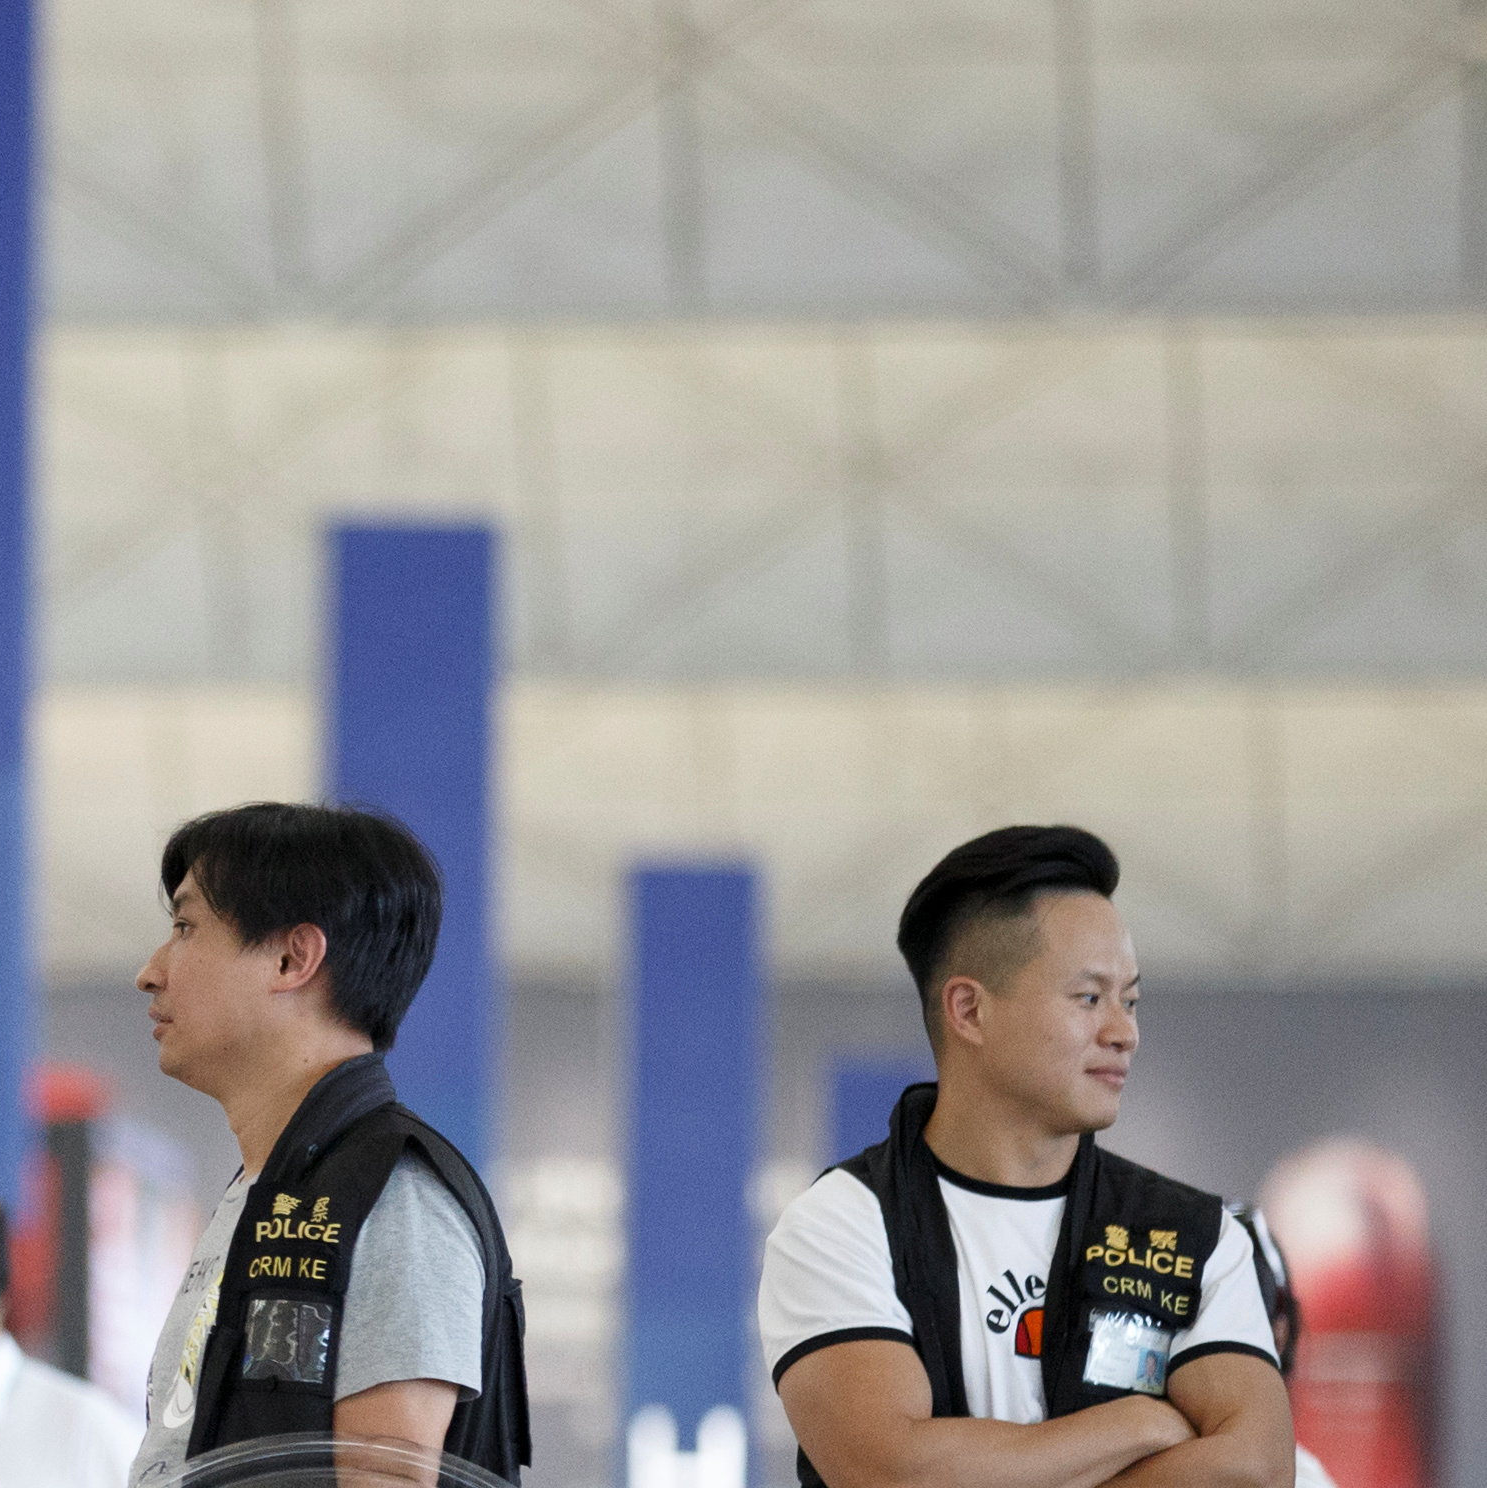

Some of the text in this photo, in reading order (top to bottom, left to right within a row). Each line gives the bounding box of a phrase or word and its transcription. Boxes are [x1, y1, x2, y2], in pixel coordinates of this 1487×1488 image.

[255, 1218, 342, 1244] POLICE
[248, 1255, 292, 1279] CRM
[298, 1257, 328, 1280] KE
[1085, 1244, 1195, 1279] POLICE
[1102, 1275, 1191, 1316] CRM KE
